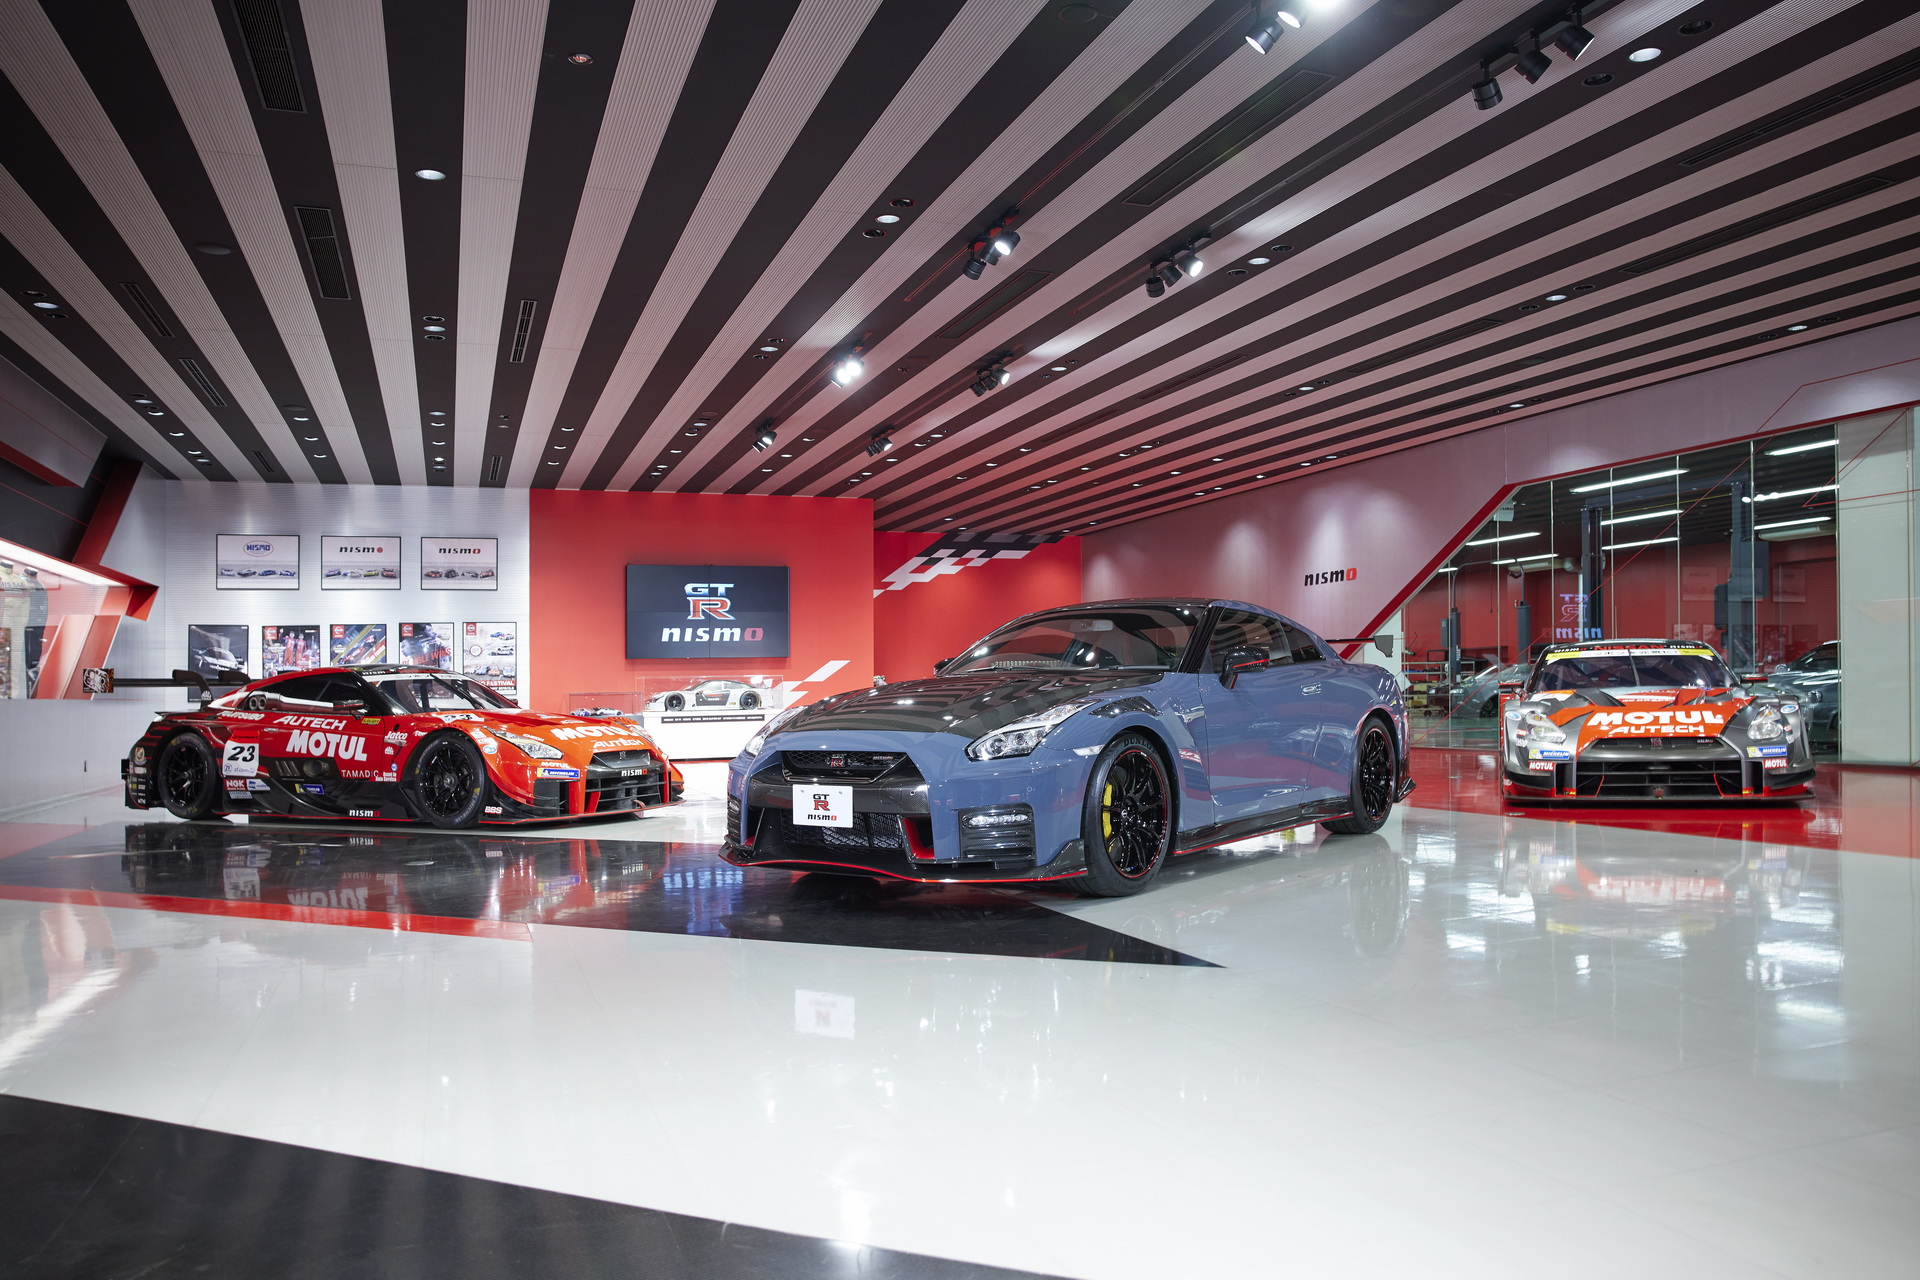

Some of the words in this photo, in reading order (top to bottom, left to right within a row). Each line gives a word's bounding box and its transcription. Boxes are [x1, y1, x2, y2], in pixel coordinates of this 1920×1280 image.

[1304, 567, 1357, 586] nismo
[661, 627, 764, 642] nismo
[273, 715, 347, 730] AUTECH
[1586, 711, 1724, 726] MOTUL
[550, 725, 642, 741] MOTUL
[1608, 725, 1705, 735] AUTECH
[286, 729, 367, 761] MOTUL
[593, 738, 644, 749] AUTECH
[227, 745, 256, 762] 23
[541, 761, 572, 769] MOTUL
[1529, 761, 1554, 770] MOTUL
[1764, 759, 1788, 768] MOTUL
[621, 769, 648, 777] nismo
[226, 779, 245, 788] NGK
[485, 806, 503, 814] BBS
[813, 800, 830, 811] R
[349, 809, 381, 817] nismo
[807, 813, 837, 822] nismo
